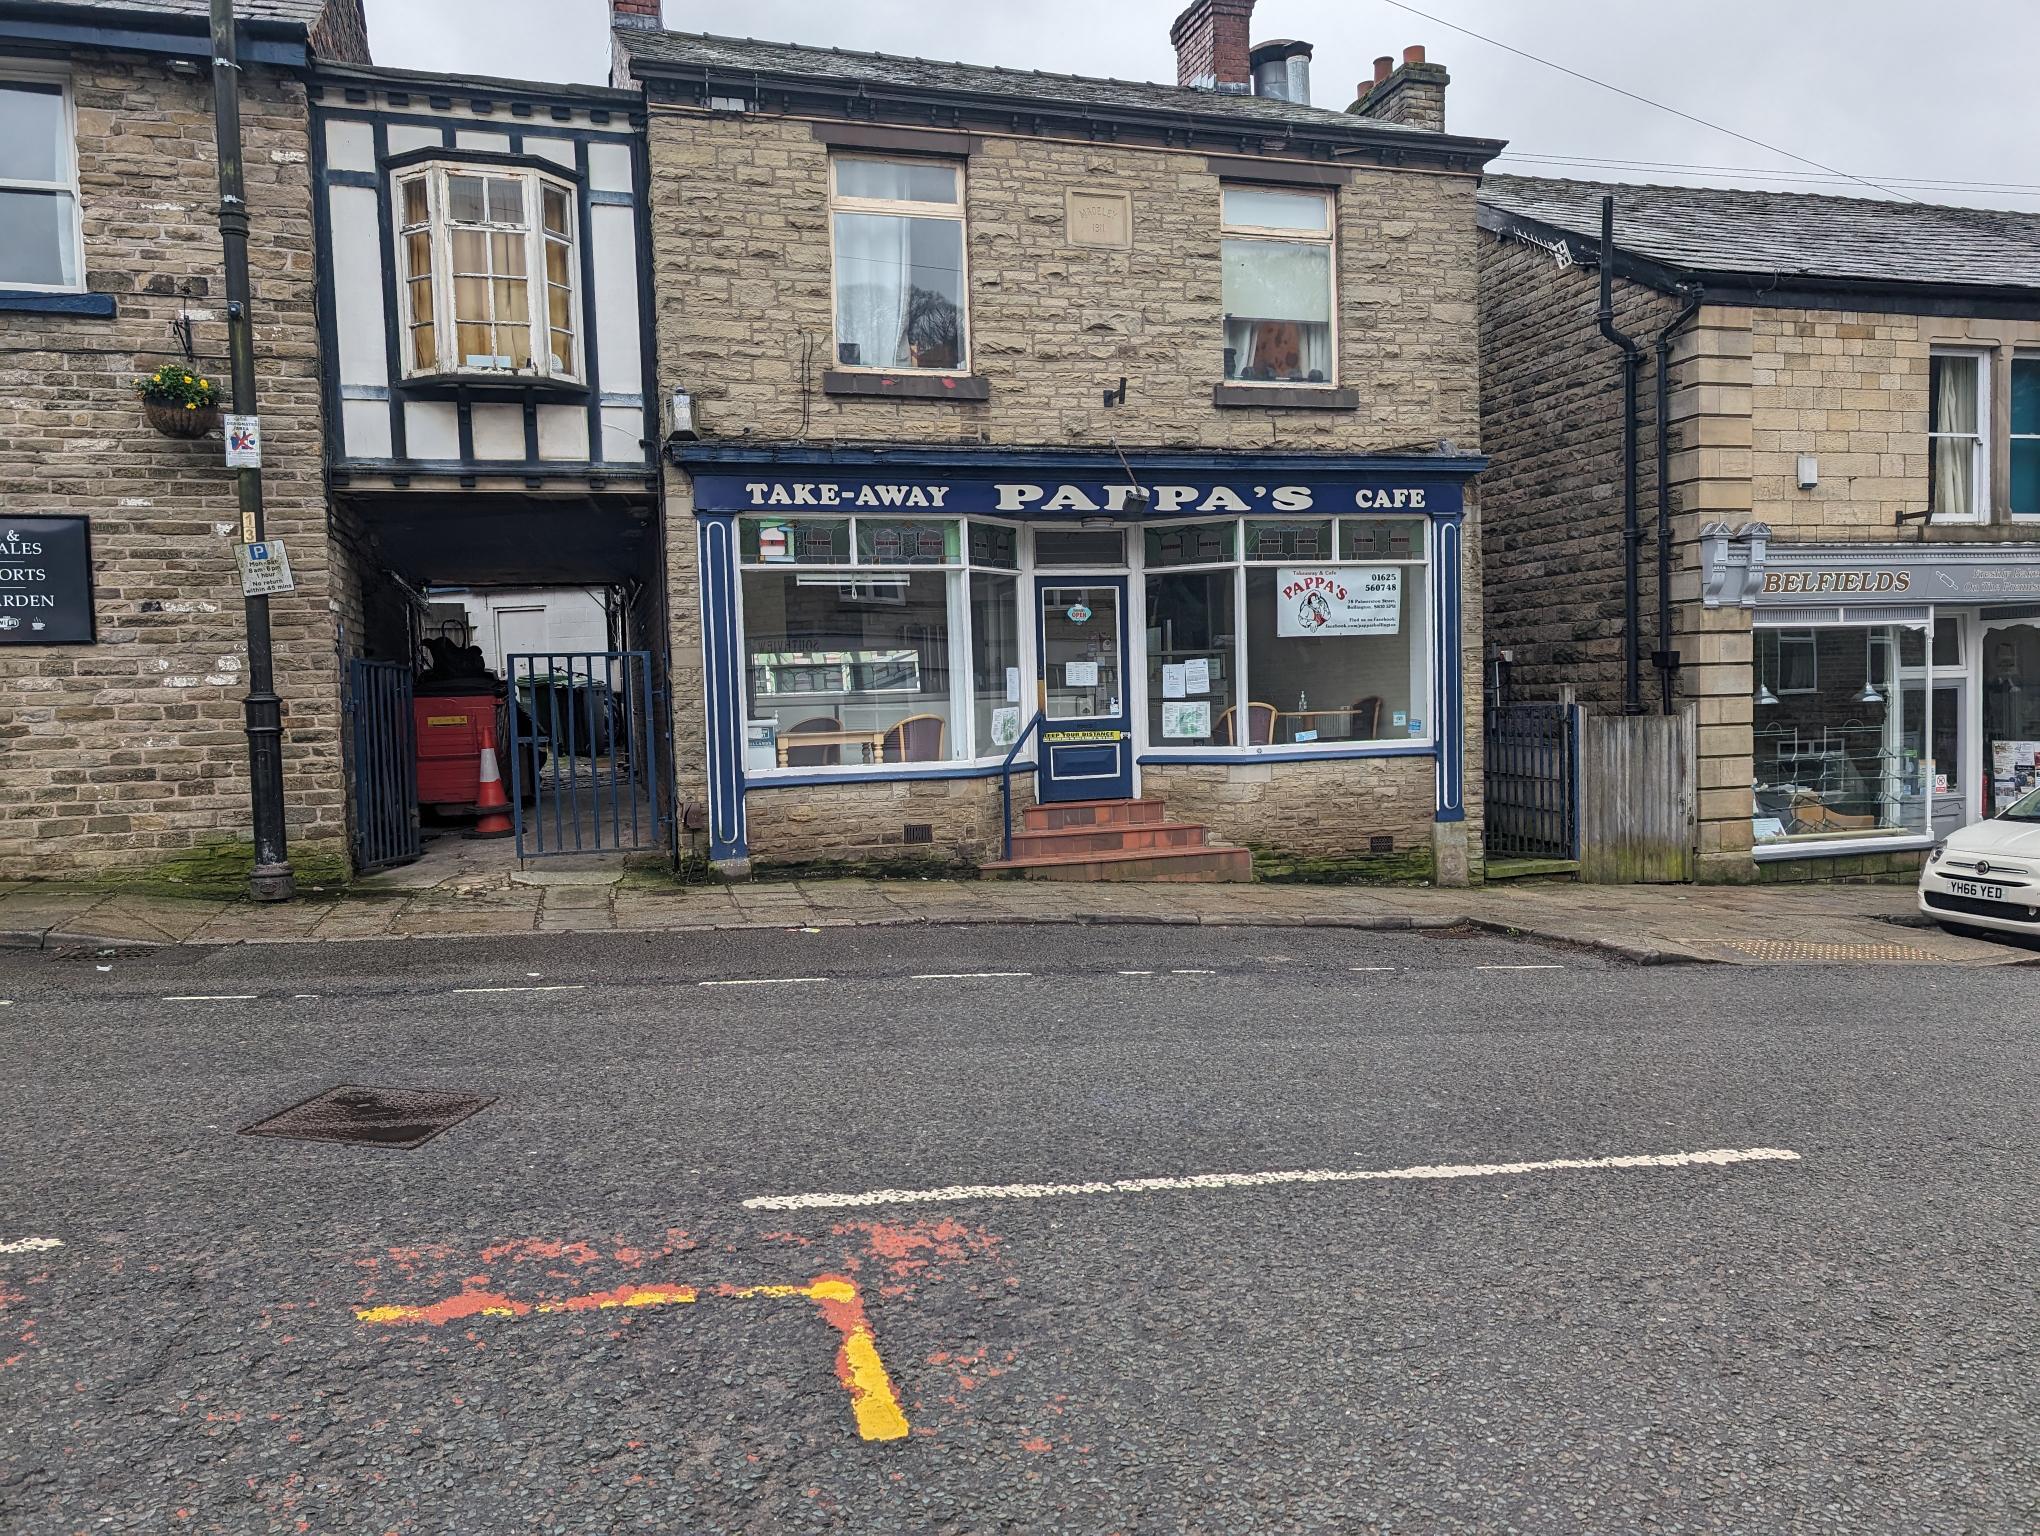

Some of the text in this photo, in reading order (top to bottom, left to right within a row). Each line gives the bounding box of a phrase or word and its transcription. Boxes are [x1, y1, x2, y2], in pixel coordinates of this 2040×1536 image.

[745, 483, 950, 507] TAKE-AWAY
[993, 484, 1314, 511] PAPPA'S
[1355, 489, 1426, 508] CAFE
[253, 545, 264, 559] P
[0, 568, 46, 581] ORTS
[1371, 573, 1397, 581] 01625
[1762, 571, 1911, 594] BELFIELDS
[1282, 576, 1348, 600] PAPPA'S
[1365, 583, 1397, 592] 560748
[0, 594, 55, 607] RDEN
[1951, 881, 2003, 899] YH66 YED
